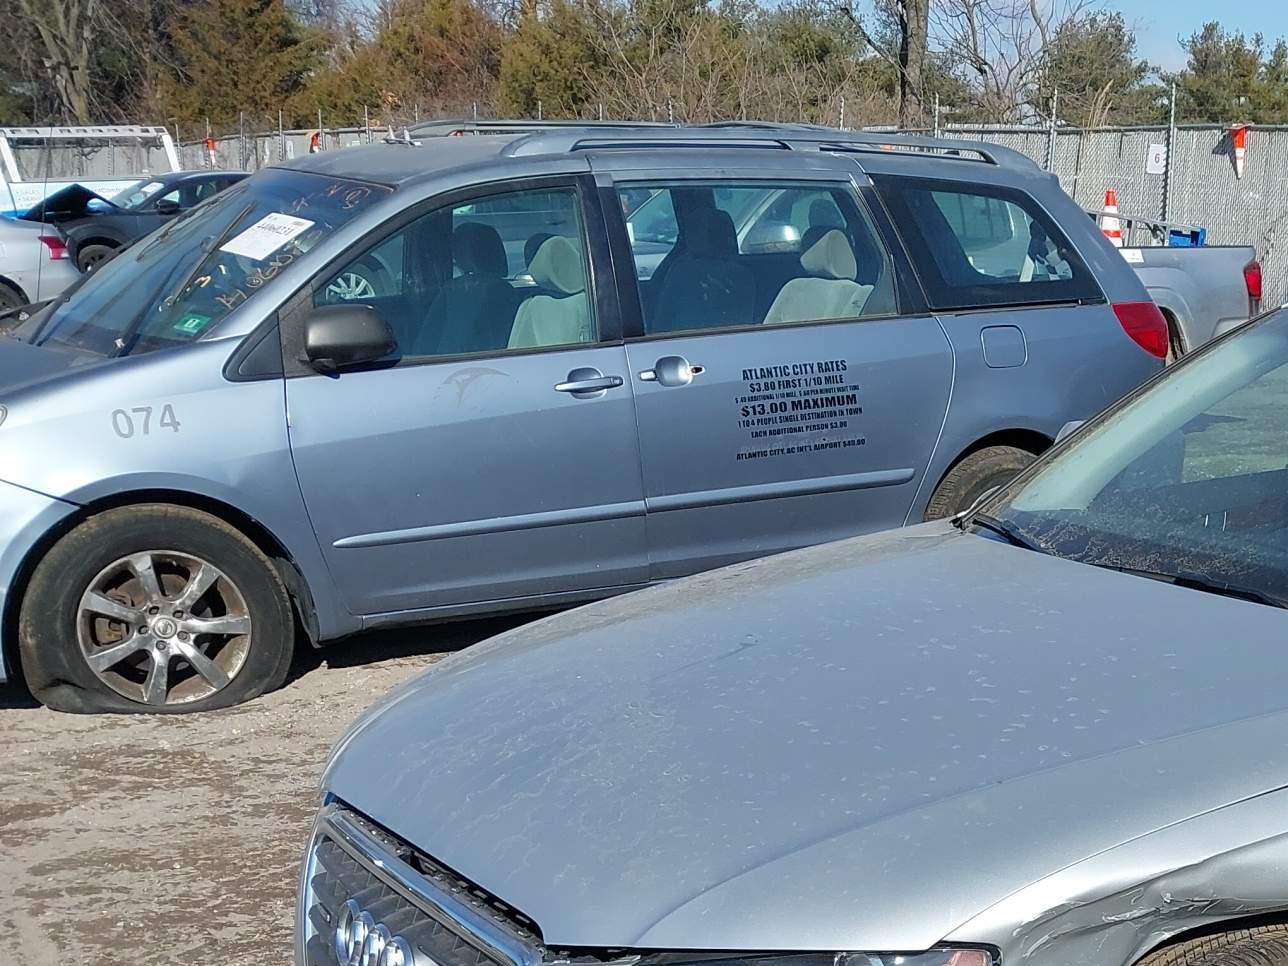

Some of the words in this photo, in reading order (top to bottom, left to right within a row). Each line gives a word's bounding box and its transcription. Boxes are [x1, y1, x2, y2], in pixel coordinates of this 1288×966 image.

[1154, 153, 1161, 164] 6
[742, 365, 790, 381] ATLANTIC
[792, 362, 815, 376] CITY
[817, 360, 847, 373] RATES
[749, 381, 776, 393] $3.80
[778, 379, 801, 390] FIRST
[804, 376, 823, 387] 1/10
[824, 374, 845, 385] MILE
[740, 401, 788, 418] $13.00
[791, 394, 857, 411] MAXIMUM
[112, 403, 181, 439] 074
[756, 416, 778, 427] PEOPLE
[778, 415, 800, 424] SINGLE
[800, 410, 837, 421] DESTINATION
[845, 407, 863, 416] TOWN
[751, 429, 768, 439] EACH
[768, 426, 805, 436] ADDITIONAL
[805, 423, 829, 433] PERSON
[736, 450, 768, 461] ATLANTIC
[813, 441, 841, 451] AIRPORT
